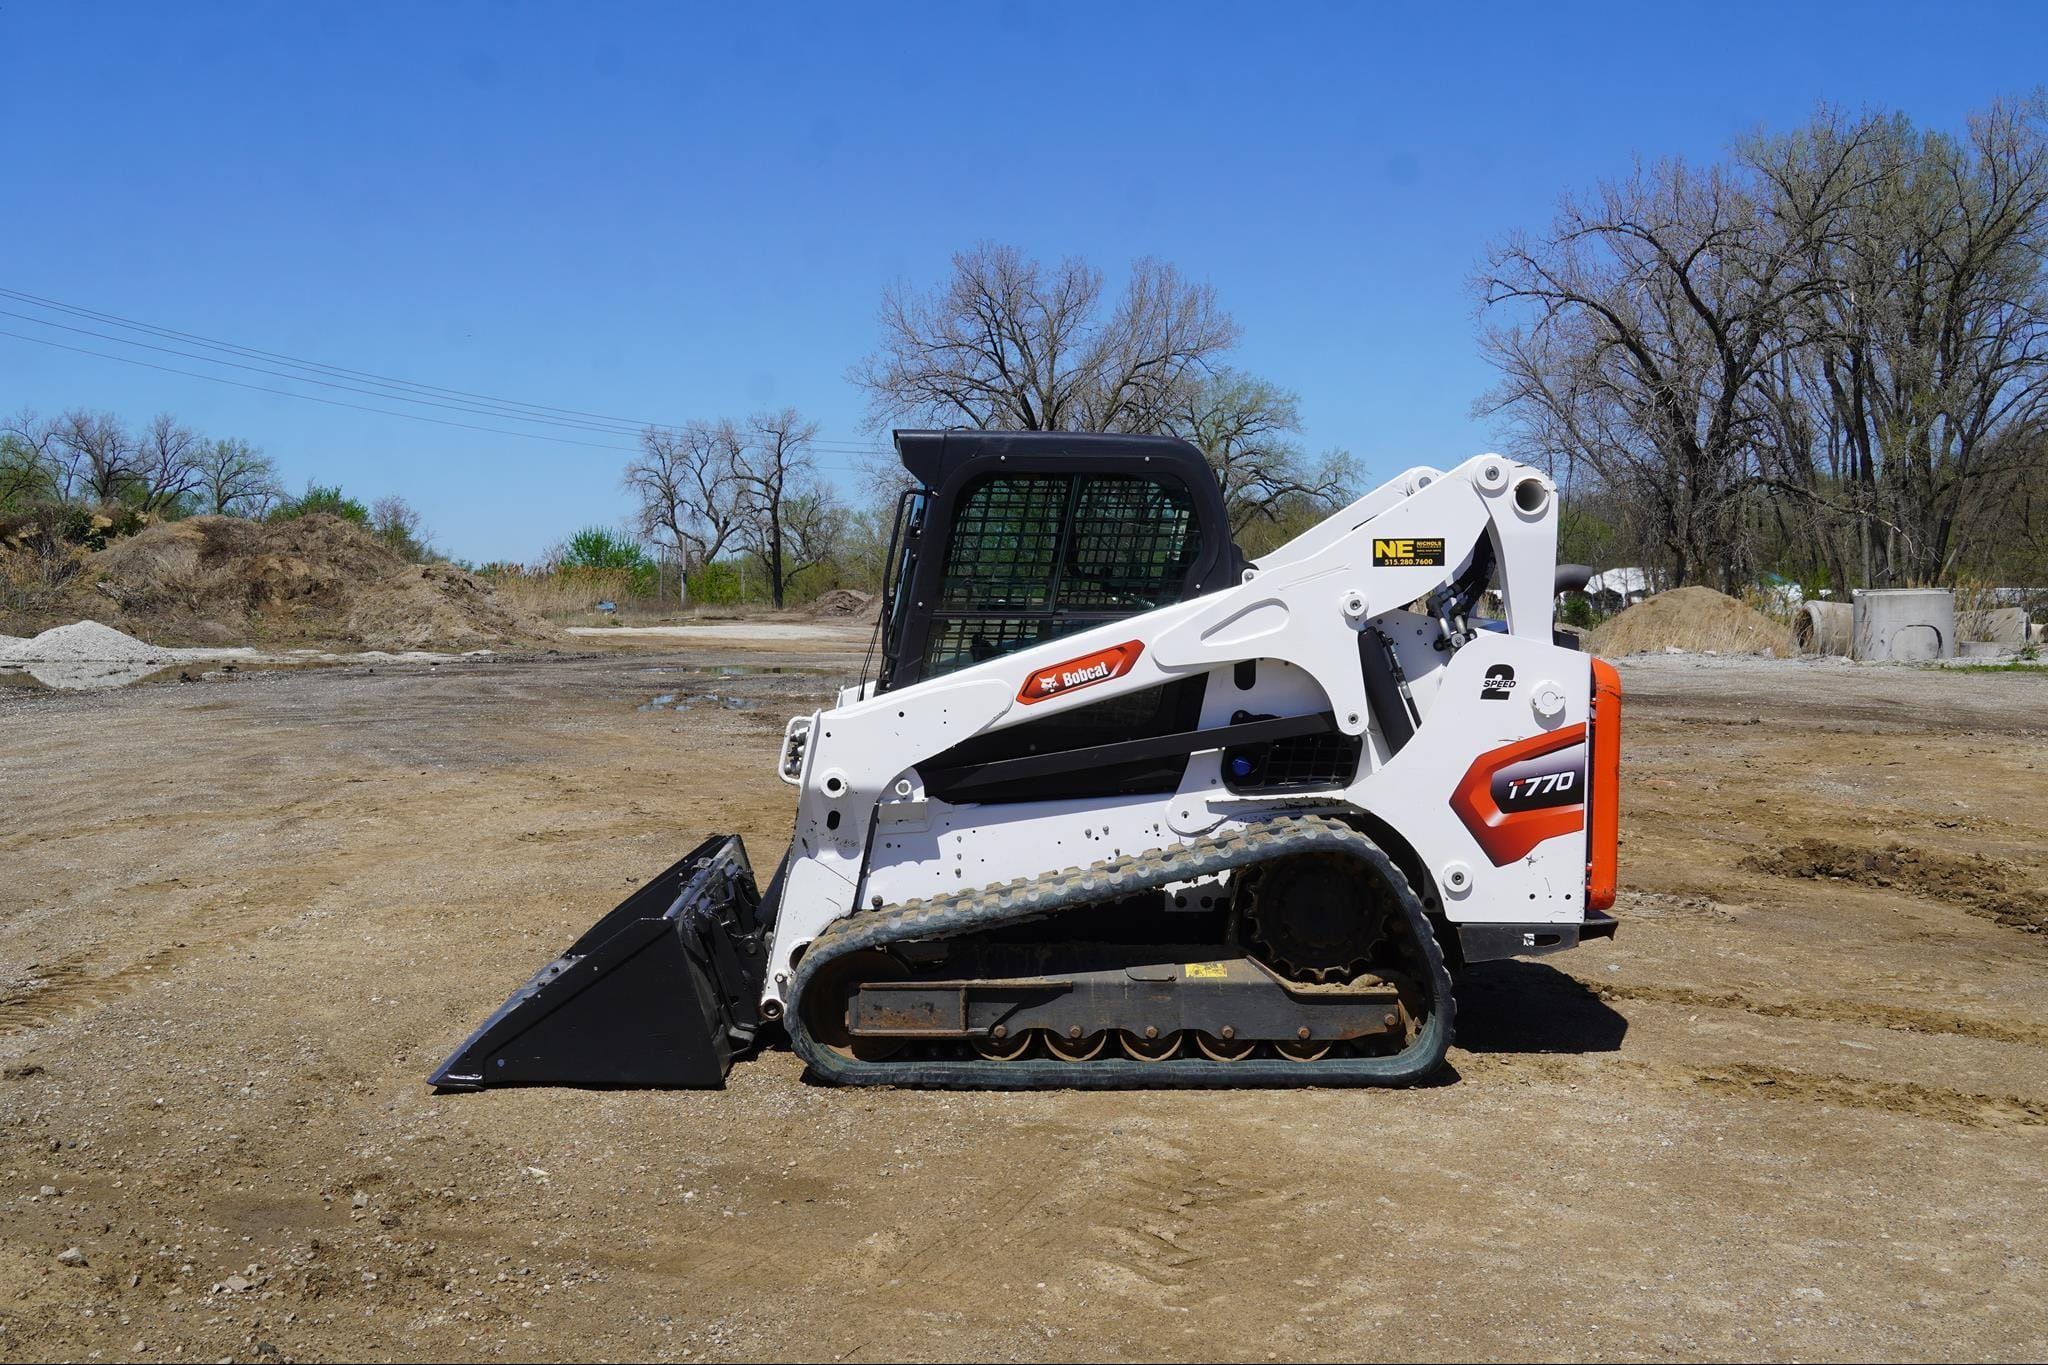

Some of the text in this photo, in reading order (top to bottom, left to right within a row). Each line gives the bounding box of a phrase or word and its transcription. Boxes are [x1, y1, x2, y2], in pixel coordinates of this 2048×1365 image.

[1375, 540, 1414, 558] NE
[1384, 558, 1433, 566] 515.280.7600
[1062, 661, 1109, 687] Bobcat
[1480, 664, 1515, 700] 2
[1483, 680, 1517, 688] SPEED
[1508, 771, 1575, 800] T770
